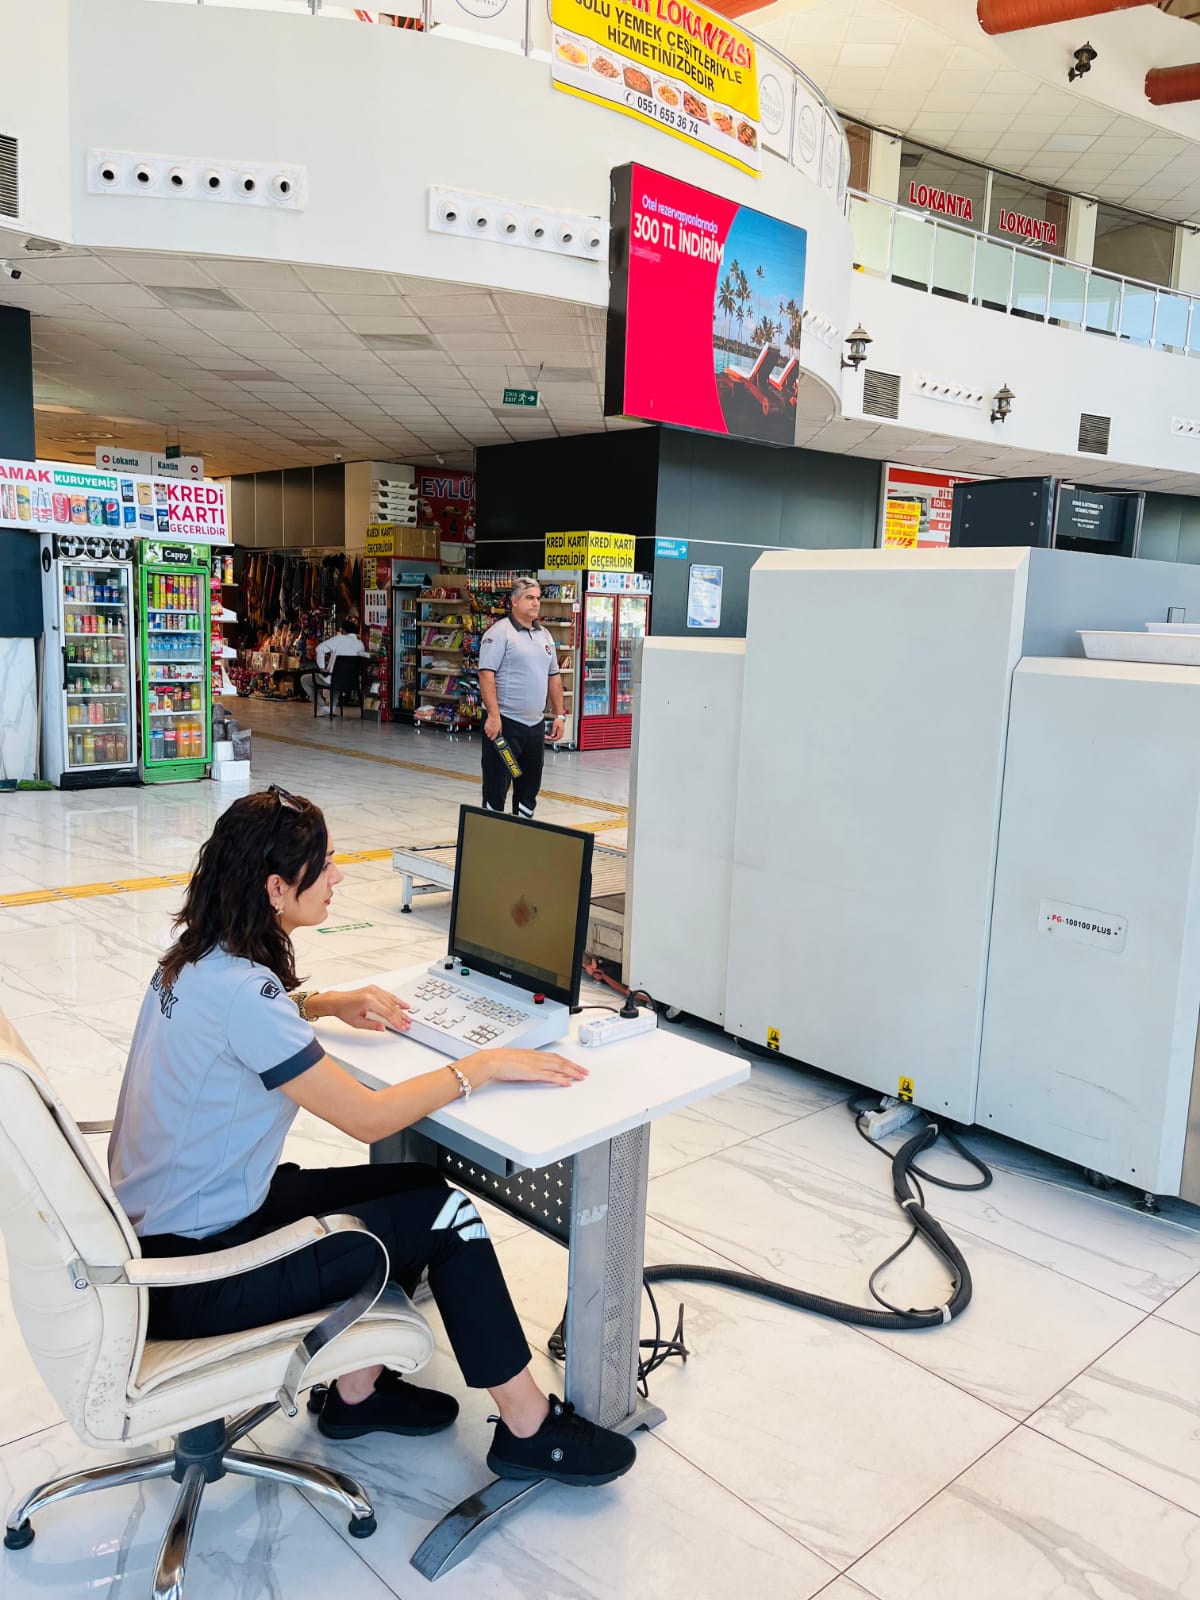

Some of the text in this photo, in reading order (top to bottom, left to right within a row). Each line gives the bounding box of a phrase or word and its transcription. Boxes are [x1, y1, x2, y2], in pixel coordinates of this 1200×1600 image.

[656, 0, 752, 71] LOKANTASI
[615, 7, 662, 42] YEMEK
[666, 31, 743, 85] ÇEŞİTLERİYLE
[607, 25, 715, 92] HİZMETİNİZDEDİR
[637, 96, 699, 136] 0551 655 36 74
[642, 194, 658, 212] Otel
[909, 181, 973, 221] LOKANTA
[1000, 209, 1057, 245] LOKANTA
[634, 212, 660, 244] 300
[662, 222, 676, 250] TL
[678, 222, 725, 267] İNDİRİM
[112, 455, 139, 467] Lokanta
[158, 461, 178, 471] Kantin
[55, 474, 117, 490] KURUYEMİŞ
[421, 476, 476, 501] EYLÜ
[167, 483, 224, 506] KREDİ
[168, 504, 225, 525] KARTI
[170, 523, 226, 537] GEÇERLİDİR
[546, 533, 587, 549] KREDİ KARTI
[589, 535, 634, 550] KREDİ KARTI
[164, 550, 189, 561] Cappy
[547, 551, 586, 568] GEÇERLİDİR
[590, 553, 633, 568] GEÇERLİDİR
[1091, 924, 1112, 936] PLUS
